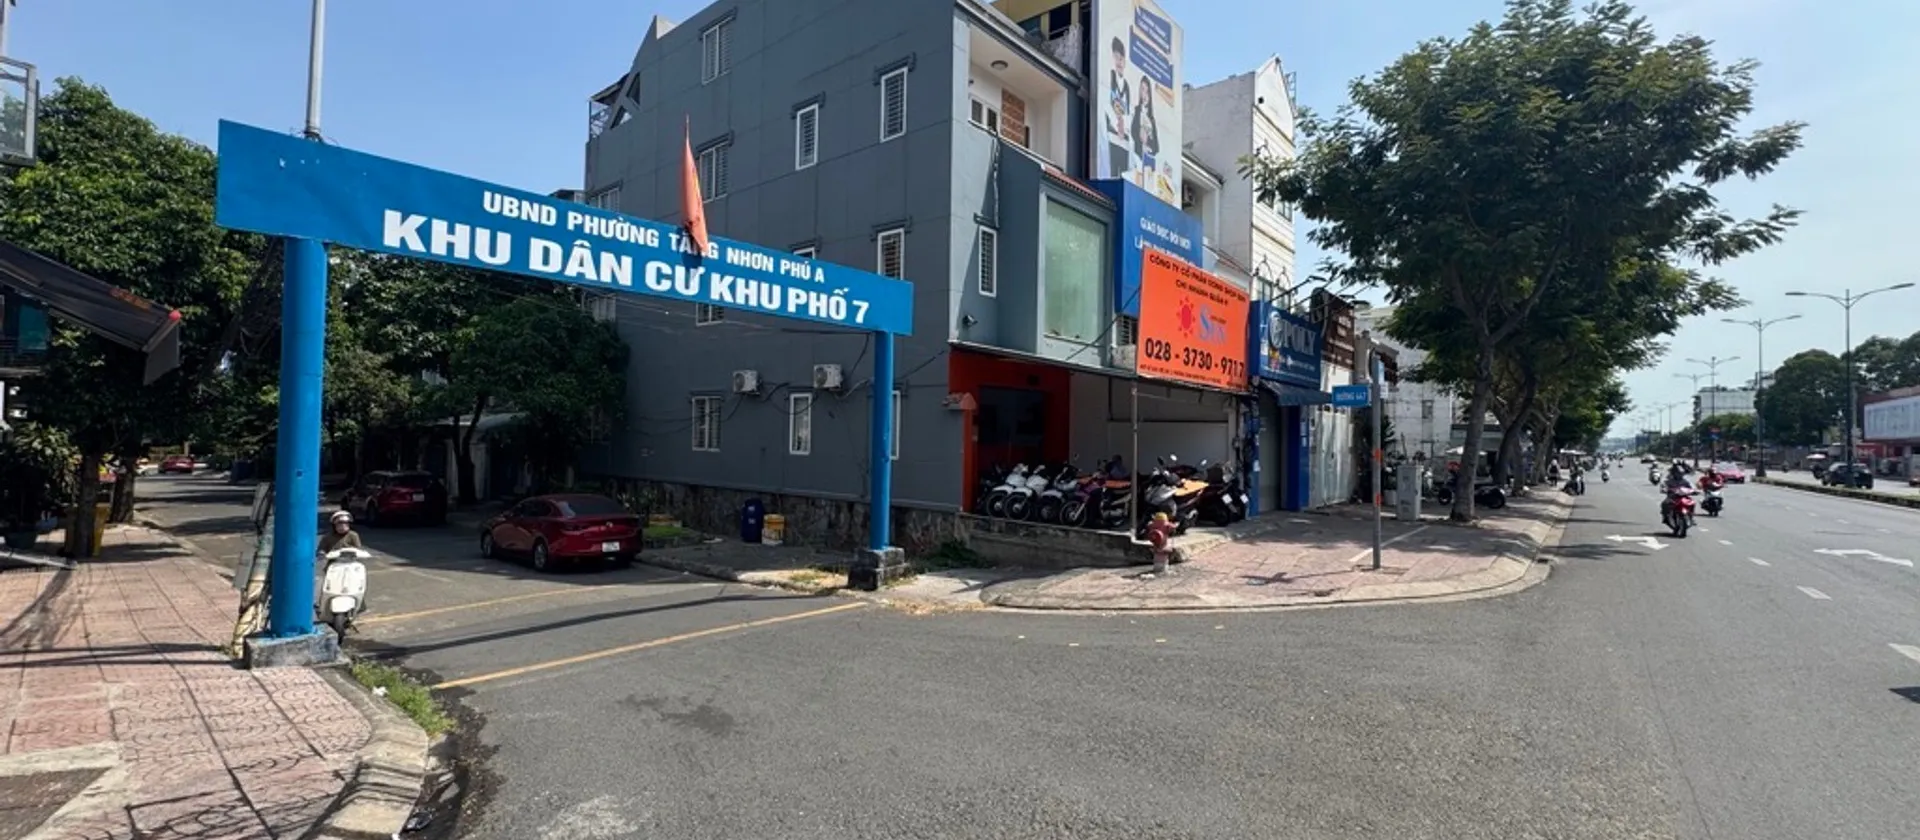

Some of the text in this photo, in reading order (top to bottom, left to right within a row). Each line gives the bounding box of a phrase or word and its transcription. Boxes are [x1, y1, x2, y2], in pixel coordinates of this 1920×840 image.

[383, 208, 870, 325] KHU DÂN CƯ KHU PHỐ 7
[483, 190, 557, 227] UBND
[567, 210, 659, 248] PHƯỜNG
[726, 246, 774, 273] NHƠN
[780, 260, 811, 281] PHÚ
[814, 267, 825, 284] A
[1149, 253, 1171, 270] CÔNG
[1171, 262, 1179, 273] TY
[1145, 337, 1171, 362] 028
[1183, 347, 1212, 371] 3730
[1221, 357, 1245, 378] 9717
